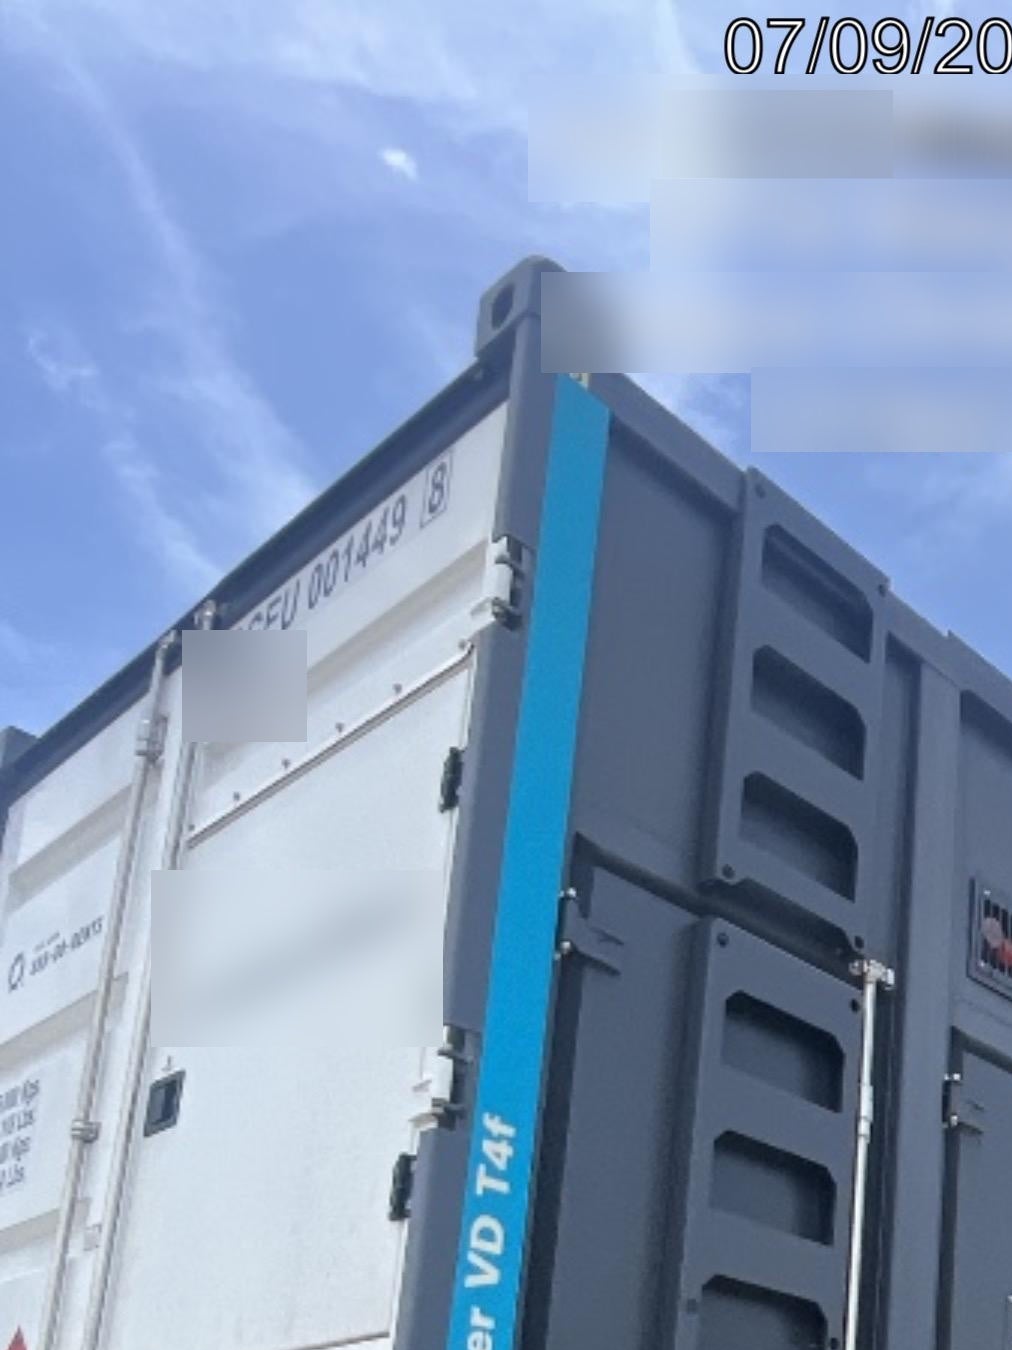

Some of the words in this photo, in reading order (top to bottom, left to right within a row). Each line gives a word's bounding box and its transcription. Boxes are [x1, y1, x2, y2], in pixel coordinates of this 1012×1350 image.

[307, 493, 407, 610] 001449
[428, 461, 447, 514] 8
[475, 1111, 518, 1196] T4f
[464, 1217, 505, 1289] VD
